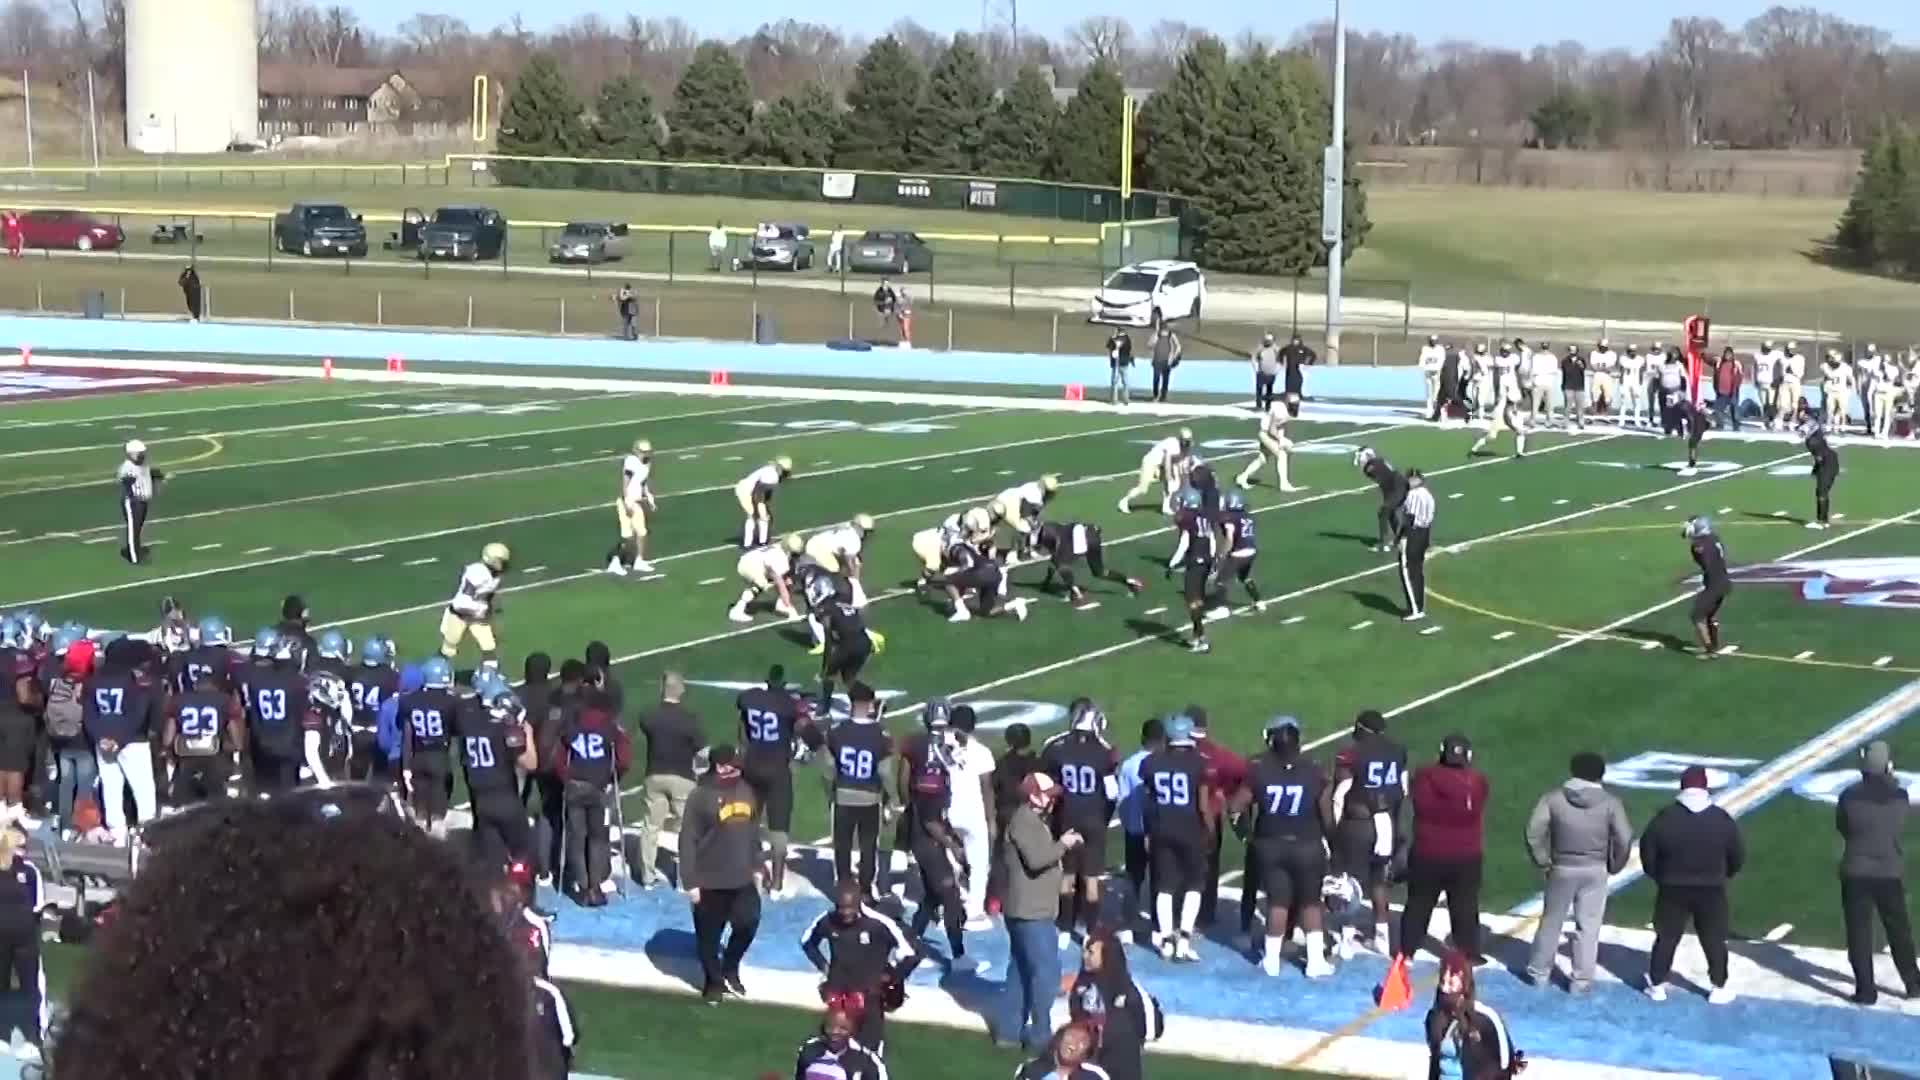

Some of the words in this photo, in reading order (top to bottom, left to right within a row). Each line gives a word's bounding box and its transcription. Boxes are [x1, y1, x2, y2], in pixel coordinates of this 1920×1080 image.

[95, 688, 123, 715] 57
[258, 689, 286, 720] 63
[181, 707, 218, 737] 23
[411, 710, 443, 737] 98
[747, 709, 779, 741] 52
[466, 736, 495, 768] 50
[571, 733, 604, 759] 42
[840, 746, 873, 779] 58
[1368, 762, 1398, 786] 54
[1154, 772, 1190, 805] 59
[1266, 785, 1304, 815] 77
